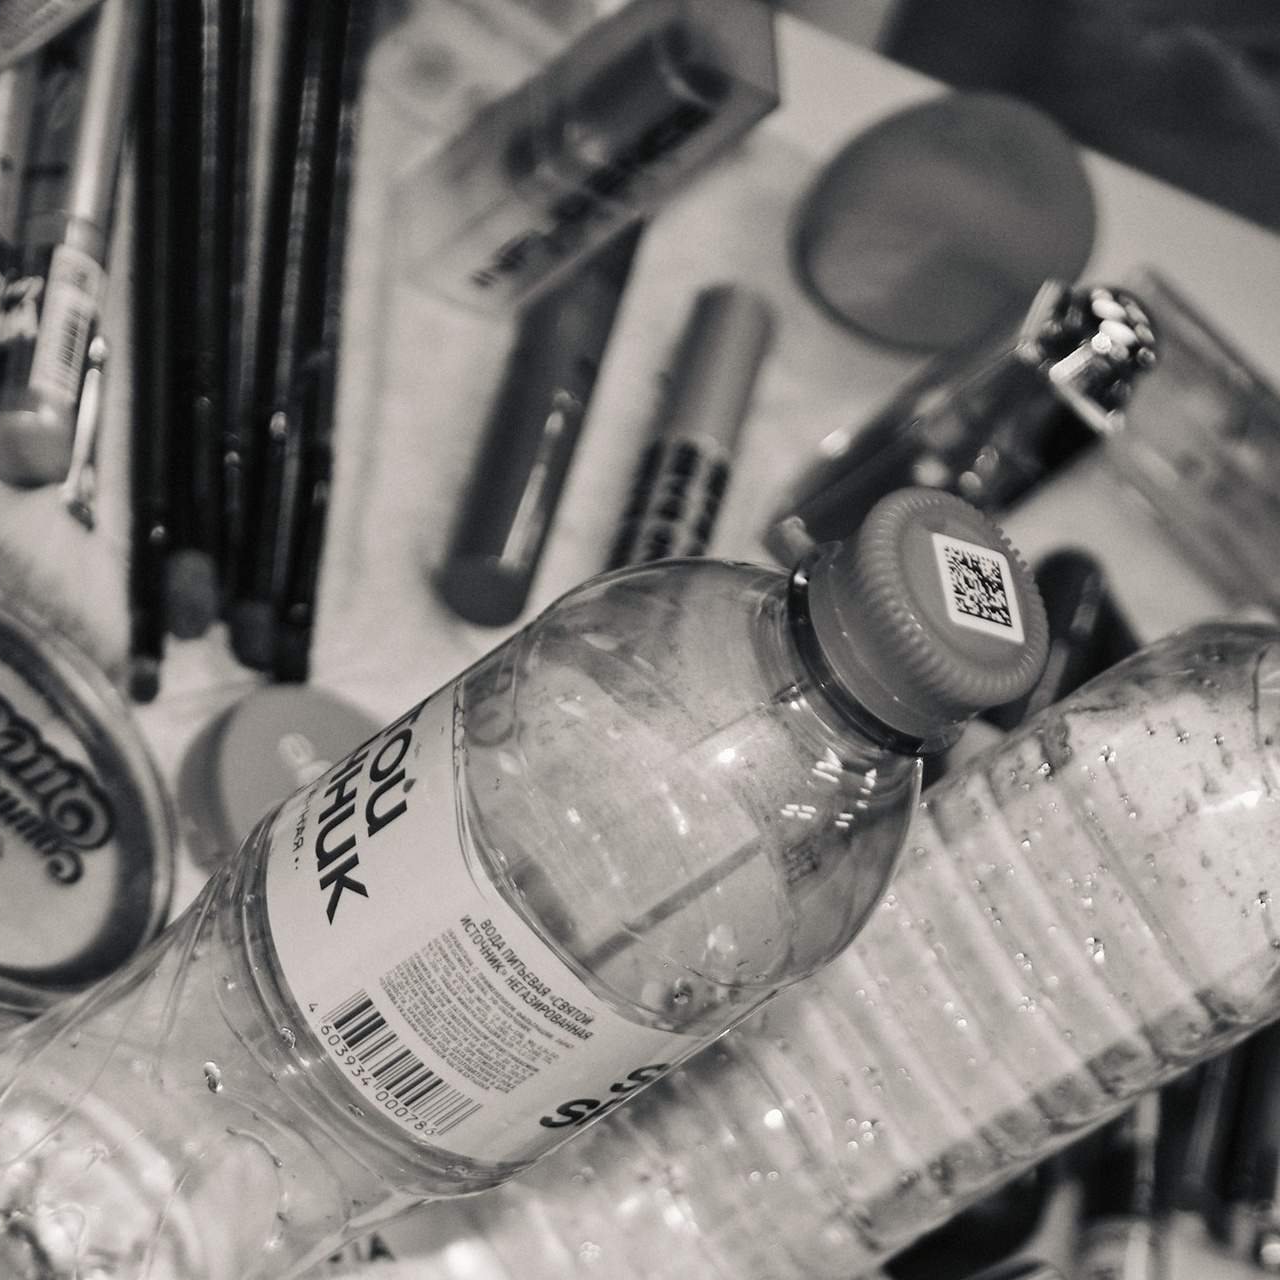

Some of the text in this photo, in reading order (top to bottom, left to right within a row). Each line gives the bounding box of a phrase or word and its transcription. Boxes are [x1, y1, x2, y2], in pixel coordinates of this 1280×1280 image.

[459, 912, 509, 978] ИСТОЧНИК»
[504, 972, 593, 1042] НЕГАЗИРОВАННАЯ
[479, 916, 595, 1027] ВОДА ПИТЬЕВАЯ «СВЯТОЙ
[306, 1000, 437, 1138] 4 603934 000786
